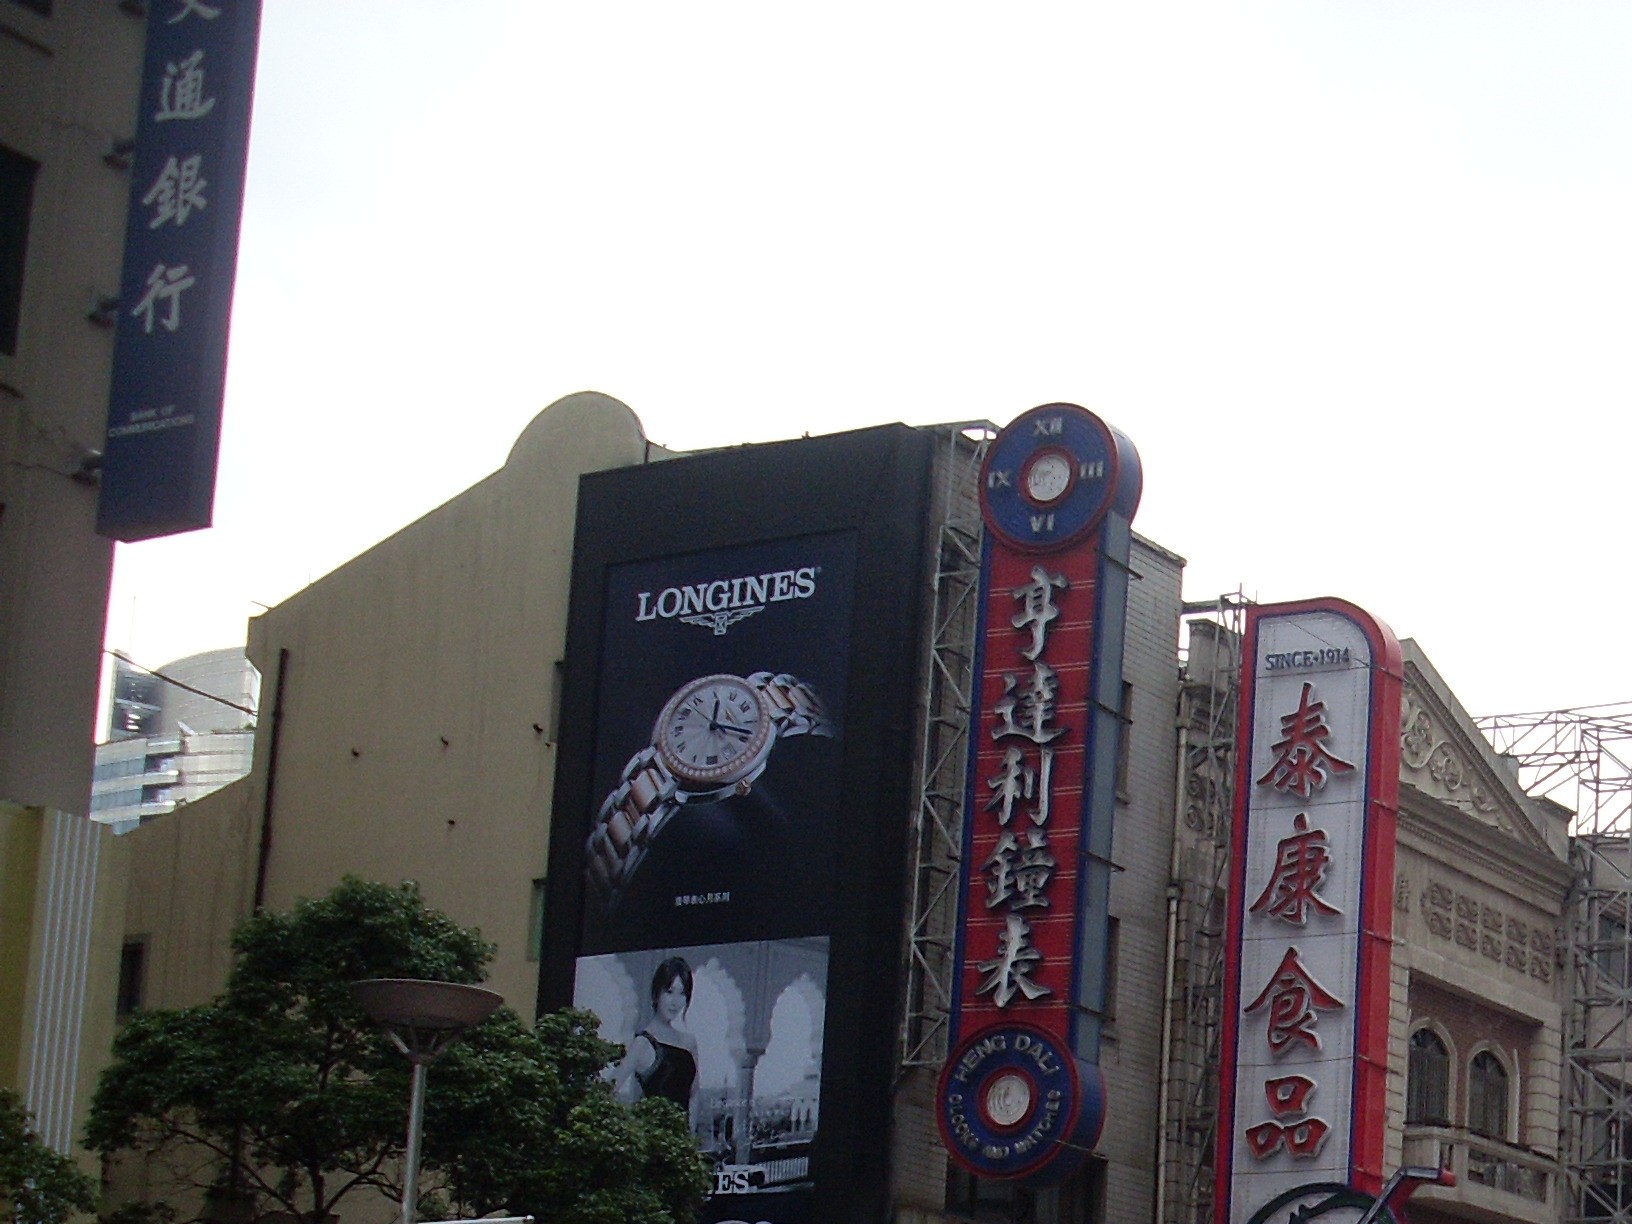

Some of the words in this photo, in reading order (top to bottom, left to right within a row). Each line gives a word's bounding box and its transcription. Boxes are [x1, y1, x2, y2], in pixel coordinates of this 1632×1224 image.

[635, 567, 817, 622] LONGINES
[1244, 681, 1356, 1161] 泰康食品
[953, 1034, 1008, 1083] HENG
